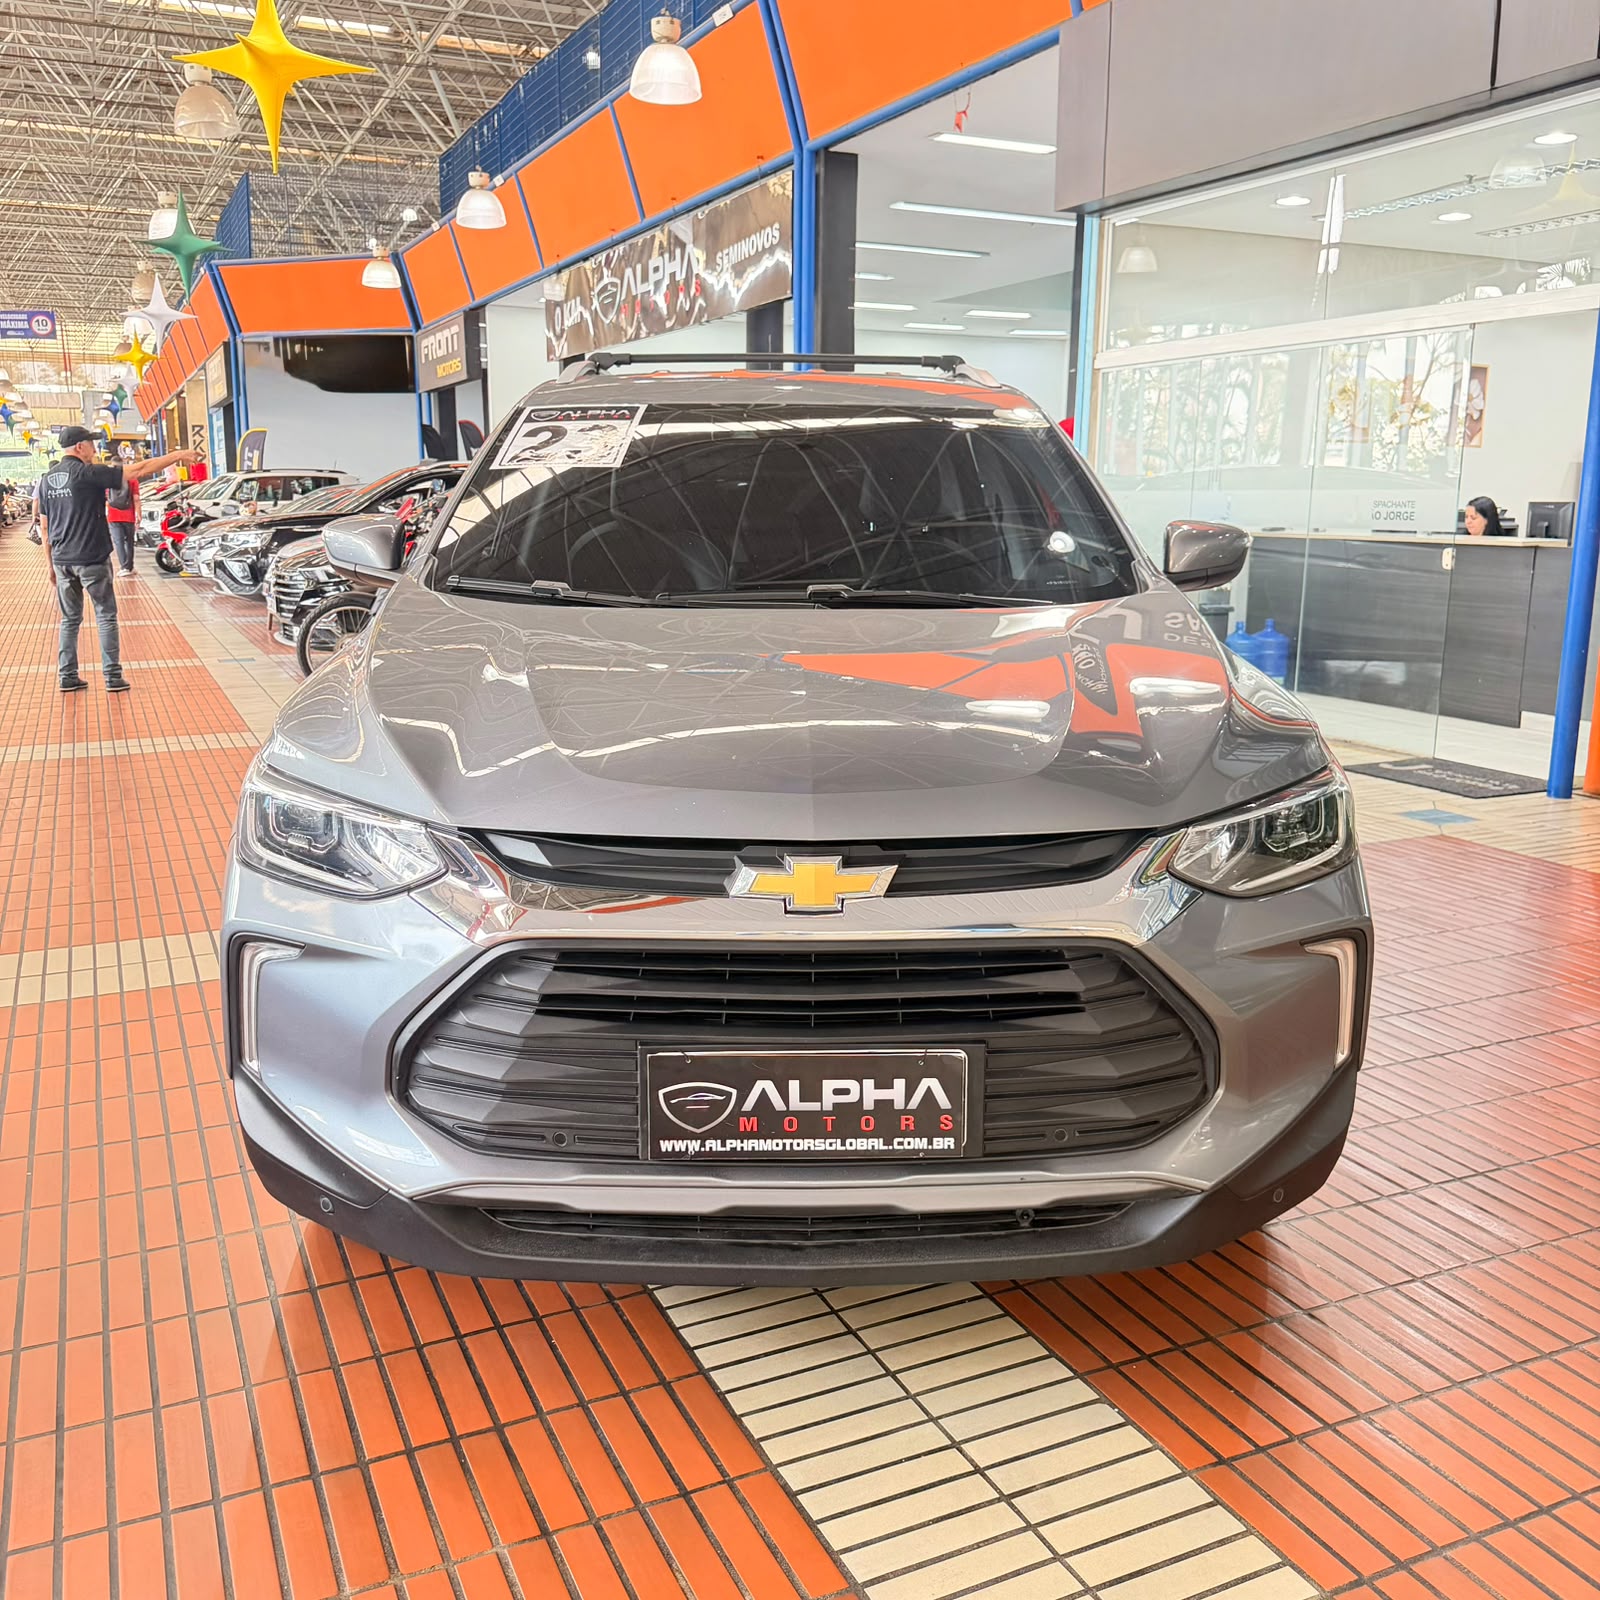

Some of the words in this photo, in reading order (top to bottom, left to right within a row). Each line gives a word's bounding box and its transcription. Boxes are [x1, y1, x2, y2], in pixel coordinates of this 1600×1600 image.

[716, 222, 780, 273] SEMINOVOS
[621, 242, 701, 301] ALPHA
[0, 319, 29, 329] MÁXIMA
[34, 319, 48, 327] 10
[421, 324, 459, 364] FRONT
[436, 357, 462, 378] MOTORS
[560, 409, 631, 417] ALPHA
[48, 488, 71, 496] ALPHA
[1383, 511, 1416, 521] JORGE
[741, 1078, 952, 1111] ALPHA
[739, 1114, 953, 1133] MOTORS
[659, 1137, 955, 1153] WWW.ALPHAMOTORSGLOBAL.COM.BR
